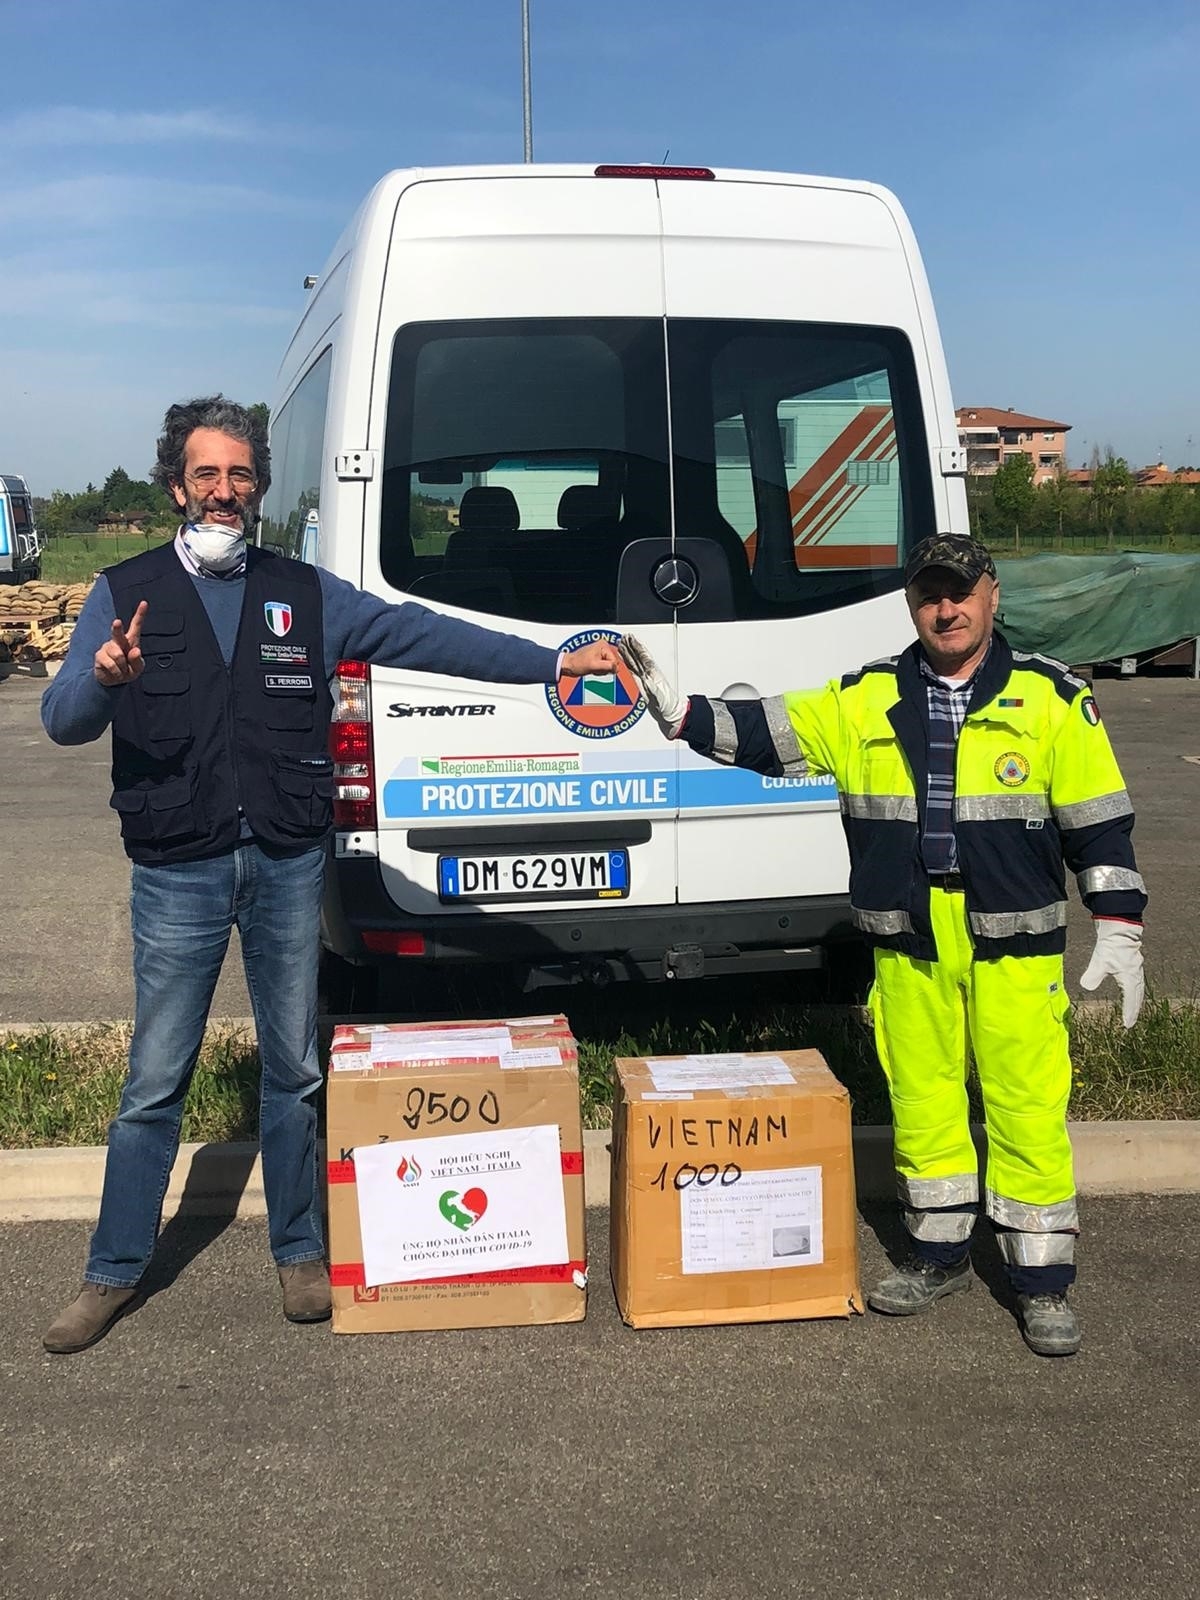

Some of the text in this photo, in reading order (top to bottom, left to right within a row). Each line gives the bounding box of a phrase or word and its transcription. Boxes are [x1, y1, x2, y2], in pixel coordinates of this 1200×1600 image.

[562, 632, 617, 654] OTEZIONE
[386, 703, 496, 718] SPRINTER
[547, 686, 648, 738] REGIONE EMILIA-ROMAG
[421, 778, 668, 811] PROTEZIONE CIVILE
[649, 1115, 788, 1149] VIETNAM
[456, 1165, 480, 1174] NAM
[487, 1161, 522, 1171] ITALIA
[651, 1162, 742, 1191] 1000
[497, 1229, 531, 1240] ITALIA
[489, 1240, 533, 1252] COVID-19
